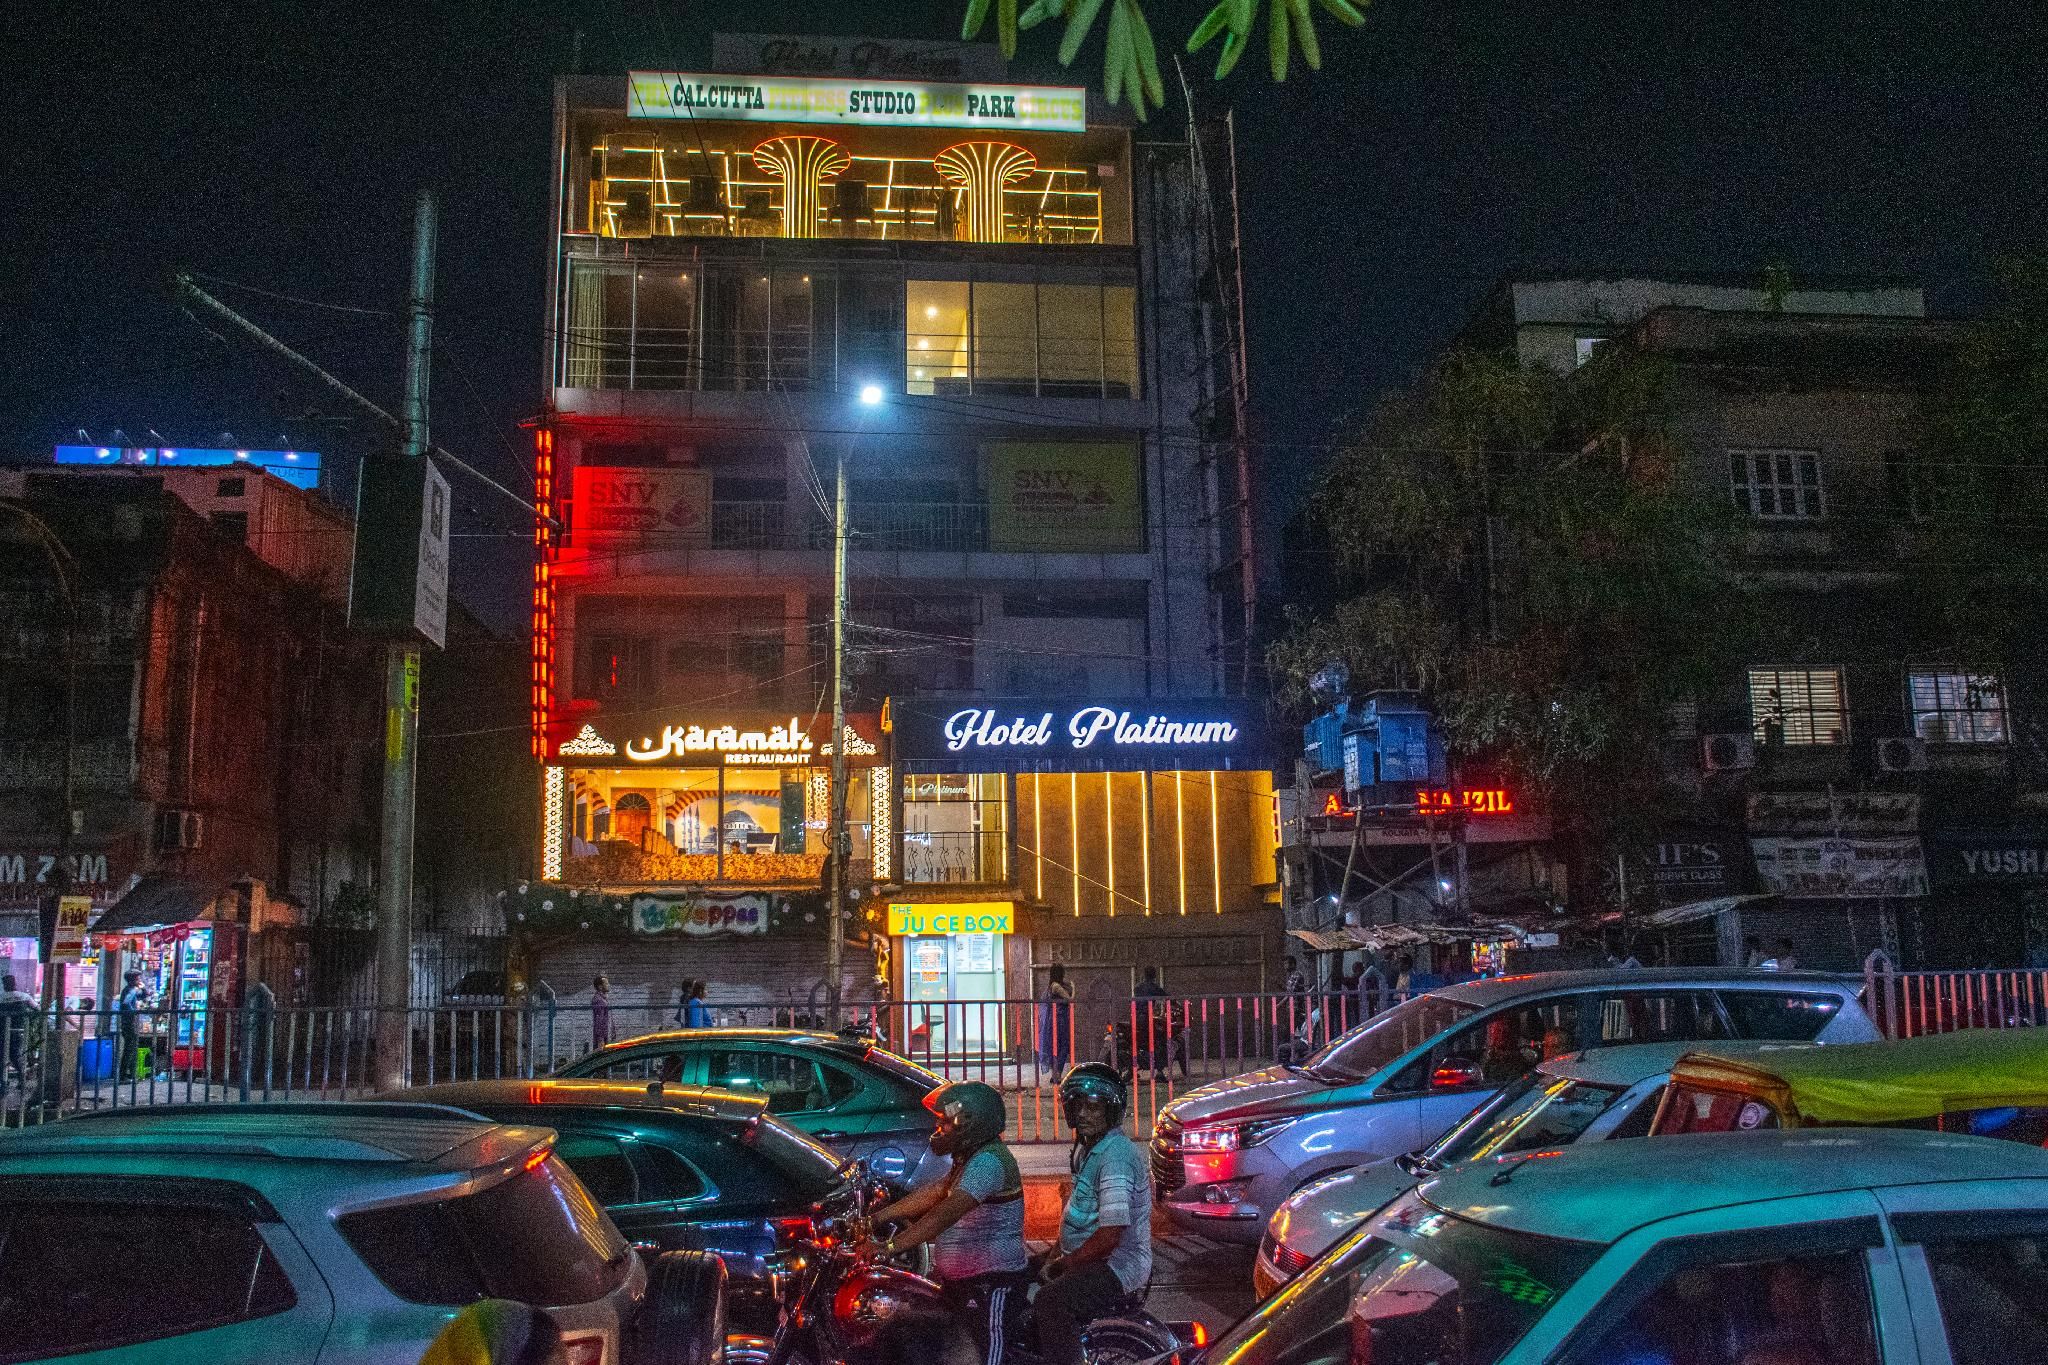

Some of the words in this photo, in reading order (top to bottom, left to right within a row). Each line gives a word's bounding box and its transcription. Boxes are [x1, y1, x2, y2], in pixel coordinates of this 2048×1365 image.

[673, 84, 765, 109] CALCUTTA
[850, 91, 915, 114] STUDIO
[967, 95, 1016, 118] PARK
[944, 709, 1053, 750] Hotel
[1068, 706, 1237, 748] Platinum
[725, 753, 811, 764] RESTAURANT
[919, 782, 968, 795] Pltinum
[891, 906, 912, 915] THE
[898, 915, 959, 933] JUCE
[964, 915, 1009, 932] BOX
